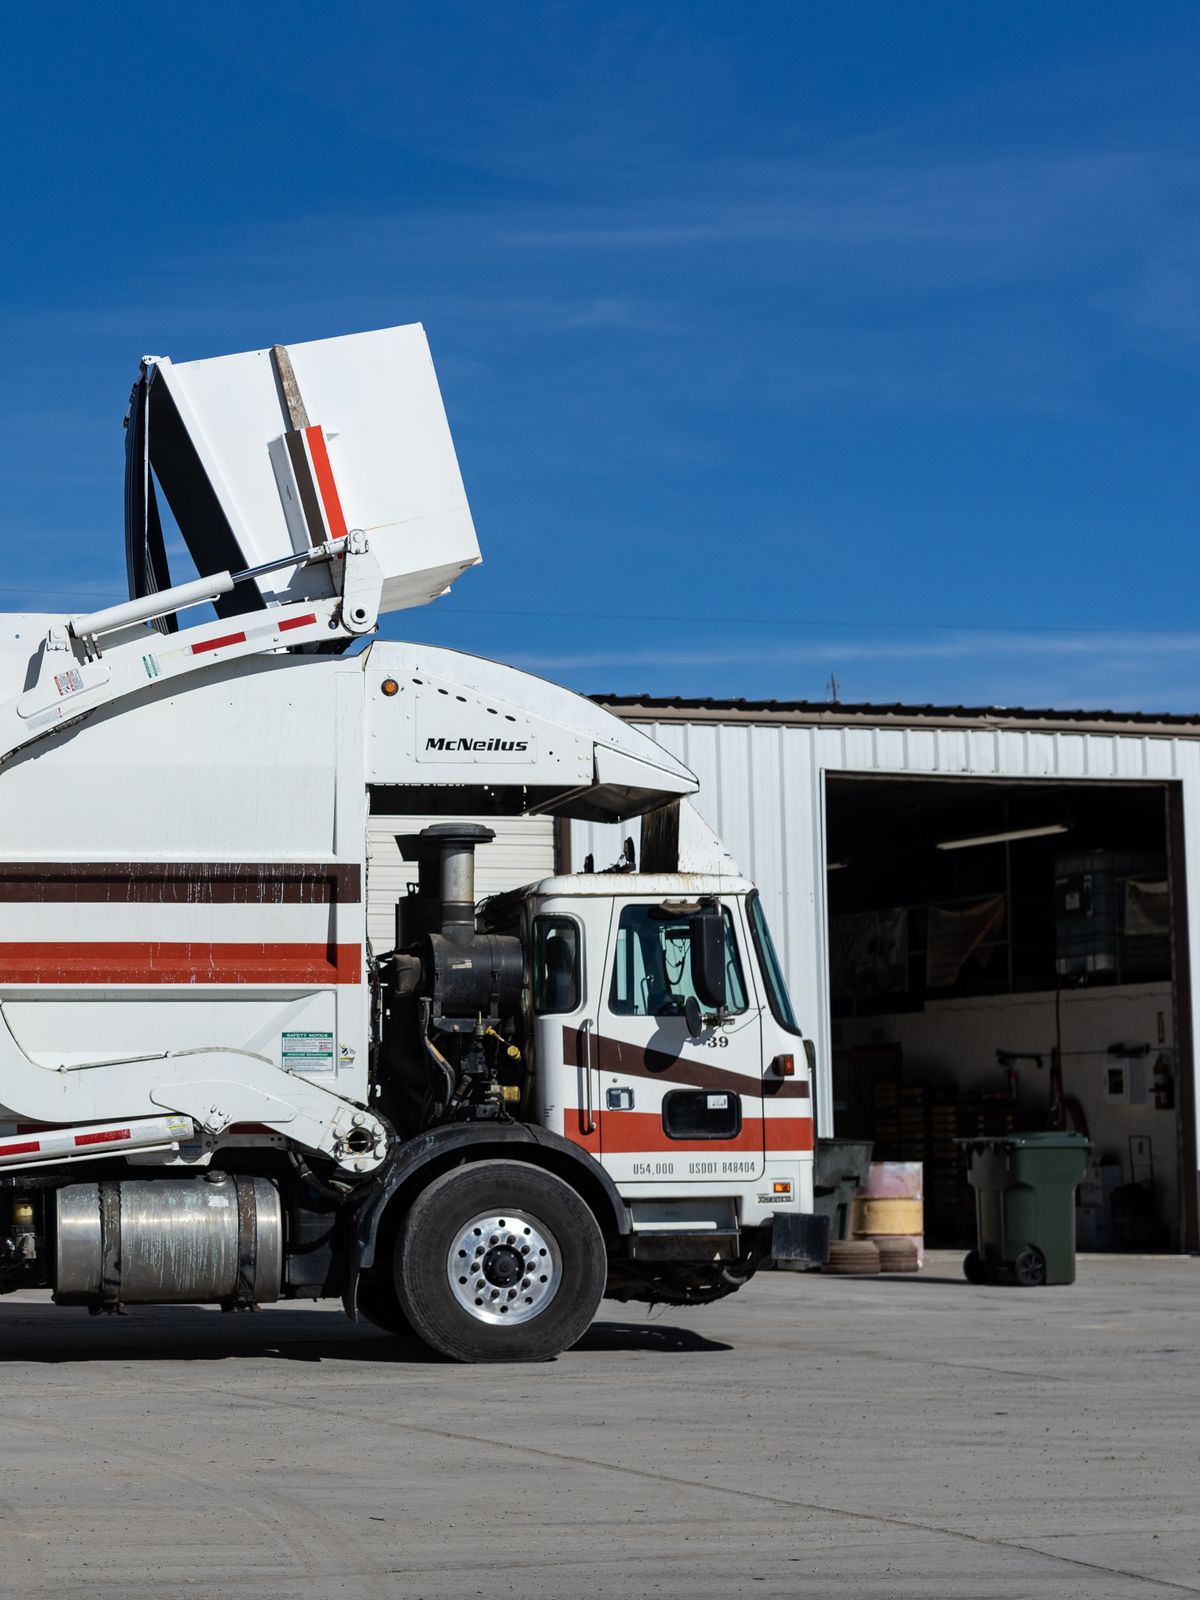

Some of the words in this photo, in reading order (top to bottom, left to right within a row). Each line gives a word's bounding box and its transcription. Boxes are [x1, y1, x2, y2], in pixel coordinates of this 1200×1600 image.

[426, 738, 528, 751] McNeilus
[707, 1036, 729, 1048] 39
[633, 1163, 673, 1175] U54,000
[689, 1162, 717, 1174] USDOT
[722, 1162, 754, 1173] 848404
